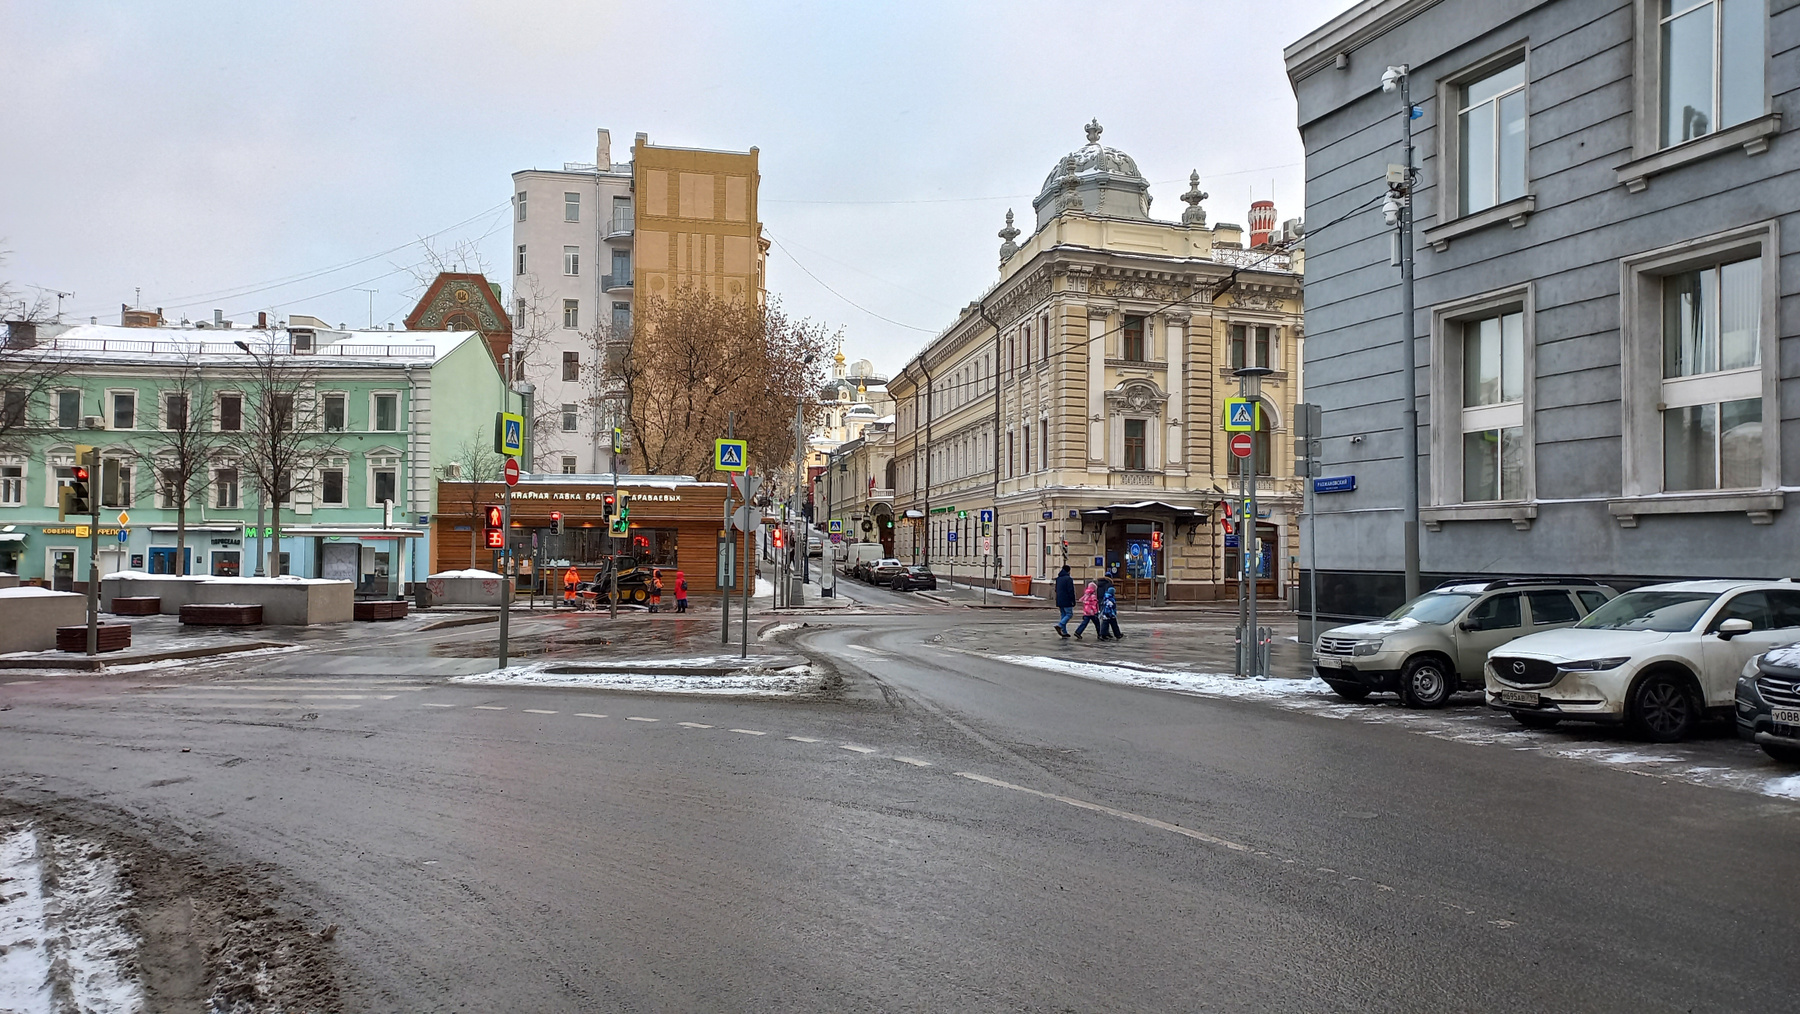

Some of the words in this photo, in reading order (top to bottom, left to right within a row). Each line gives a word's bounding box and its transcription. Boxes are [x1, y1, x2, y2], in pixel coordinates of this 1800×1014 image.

[494, 491, 549, 499] КУИНАРНАЯ
[553, 492, 581, 500] ЛАВКА
[629, 494, 681, 502] АРАВАЕВЫХ
